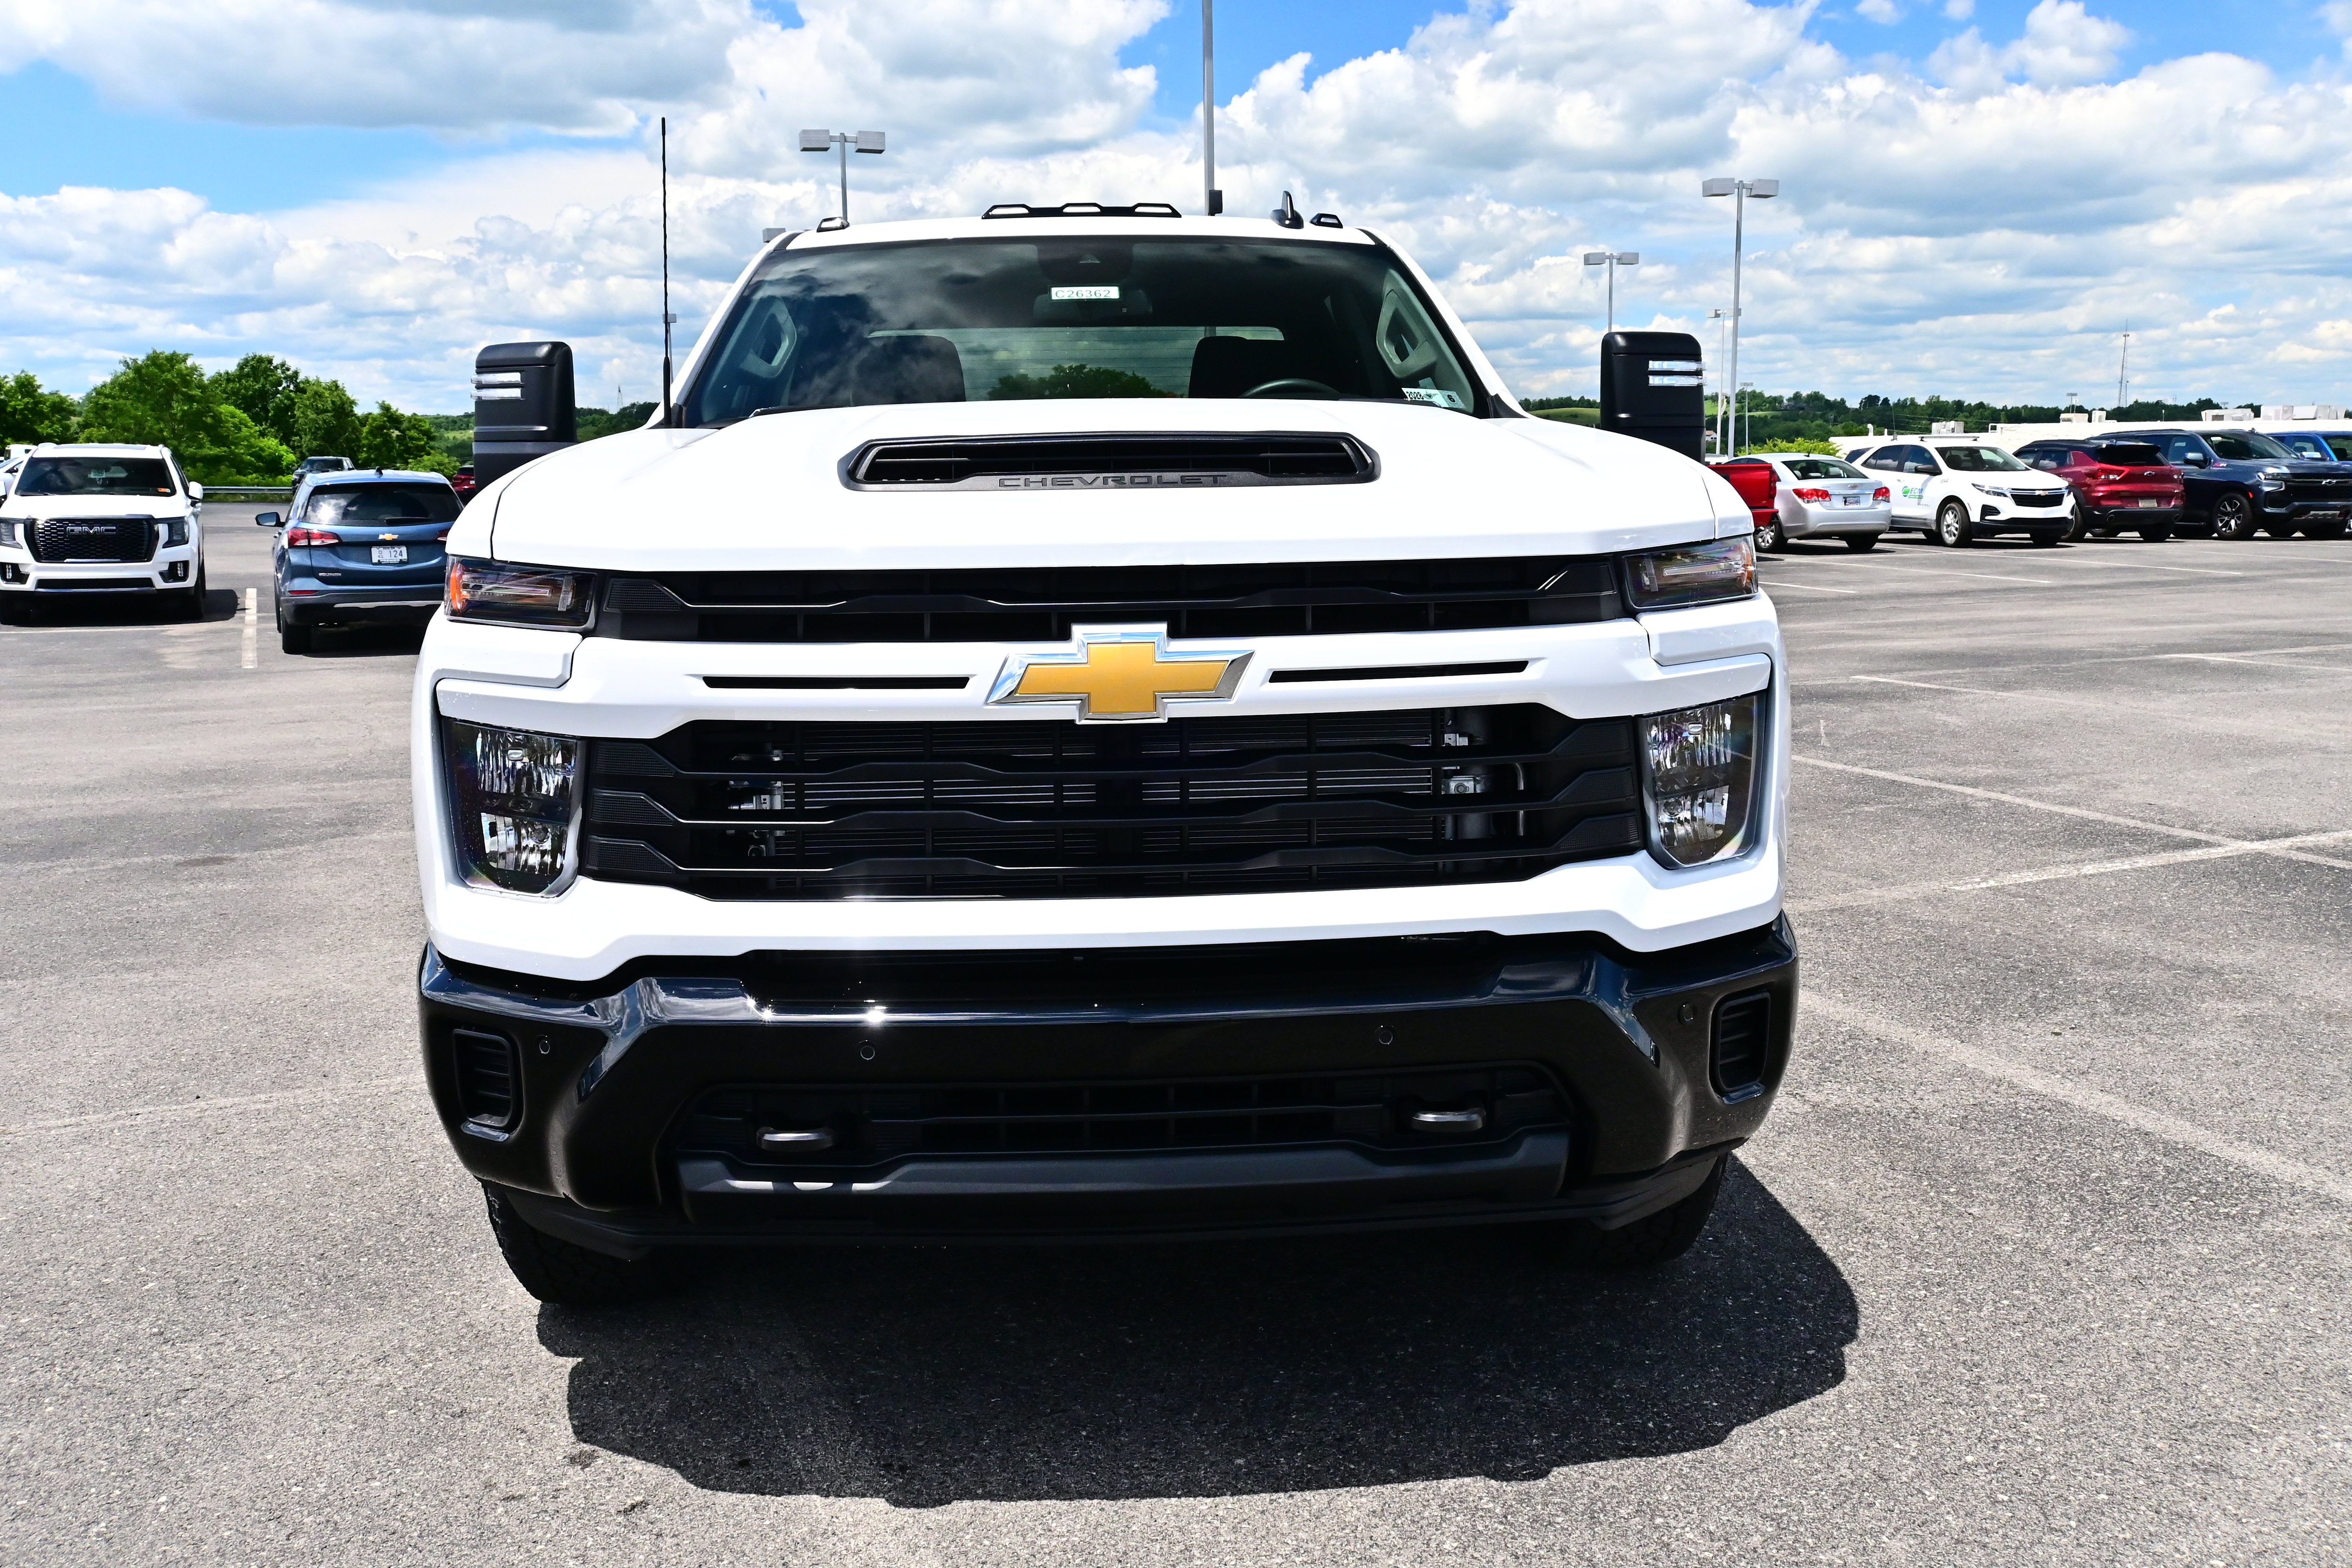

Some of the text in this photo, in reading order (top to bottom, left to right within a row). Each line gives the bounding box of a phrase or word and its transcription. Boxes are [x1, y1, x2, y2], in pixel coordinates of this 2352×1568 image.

[1055, 289, 1111, 298] C26362
[1406, 391, 1424, 400] 2028
[1447, 394, 1456, 403] 6
[999, 474, 1227, 488] CHEVROLET
[66, 526, 116, 535] GMC
